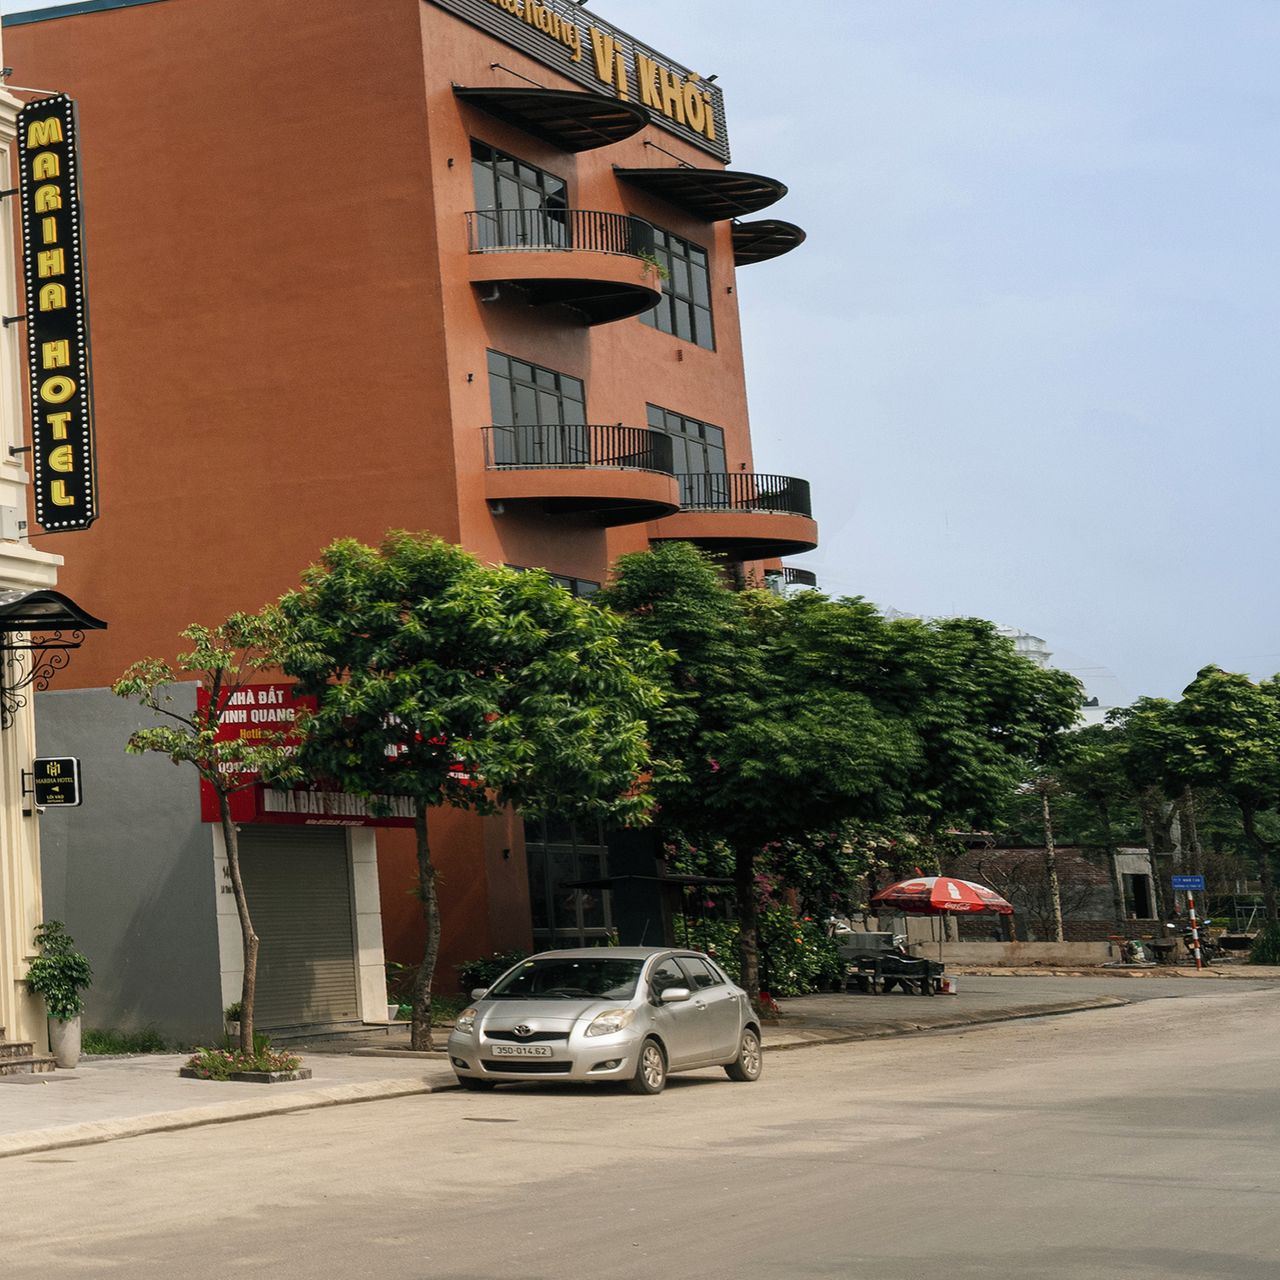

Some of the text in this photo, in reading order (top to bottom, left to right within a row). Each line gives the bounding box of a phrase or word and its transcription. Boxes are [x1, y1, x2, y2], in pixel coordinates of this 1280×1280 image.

[26, 116, 76, 506] MARIHA HOTEL
[258, 686, 284, 704] ĐẤT
[251, 708, 295, 723] QUANG
